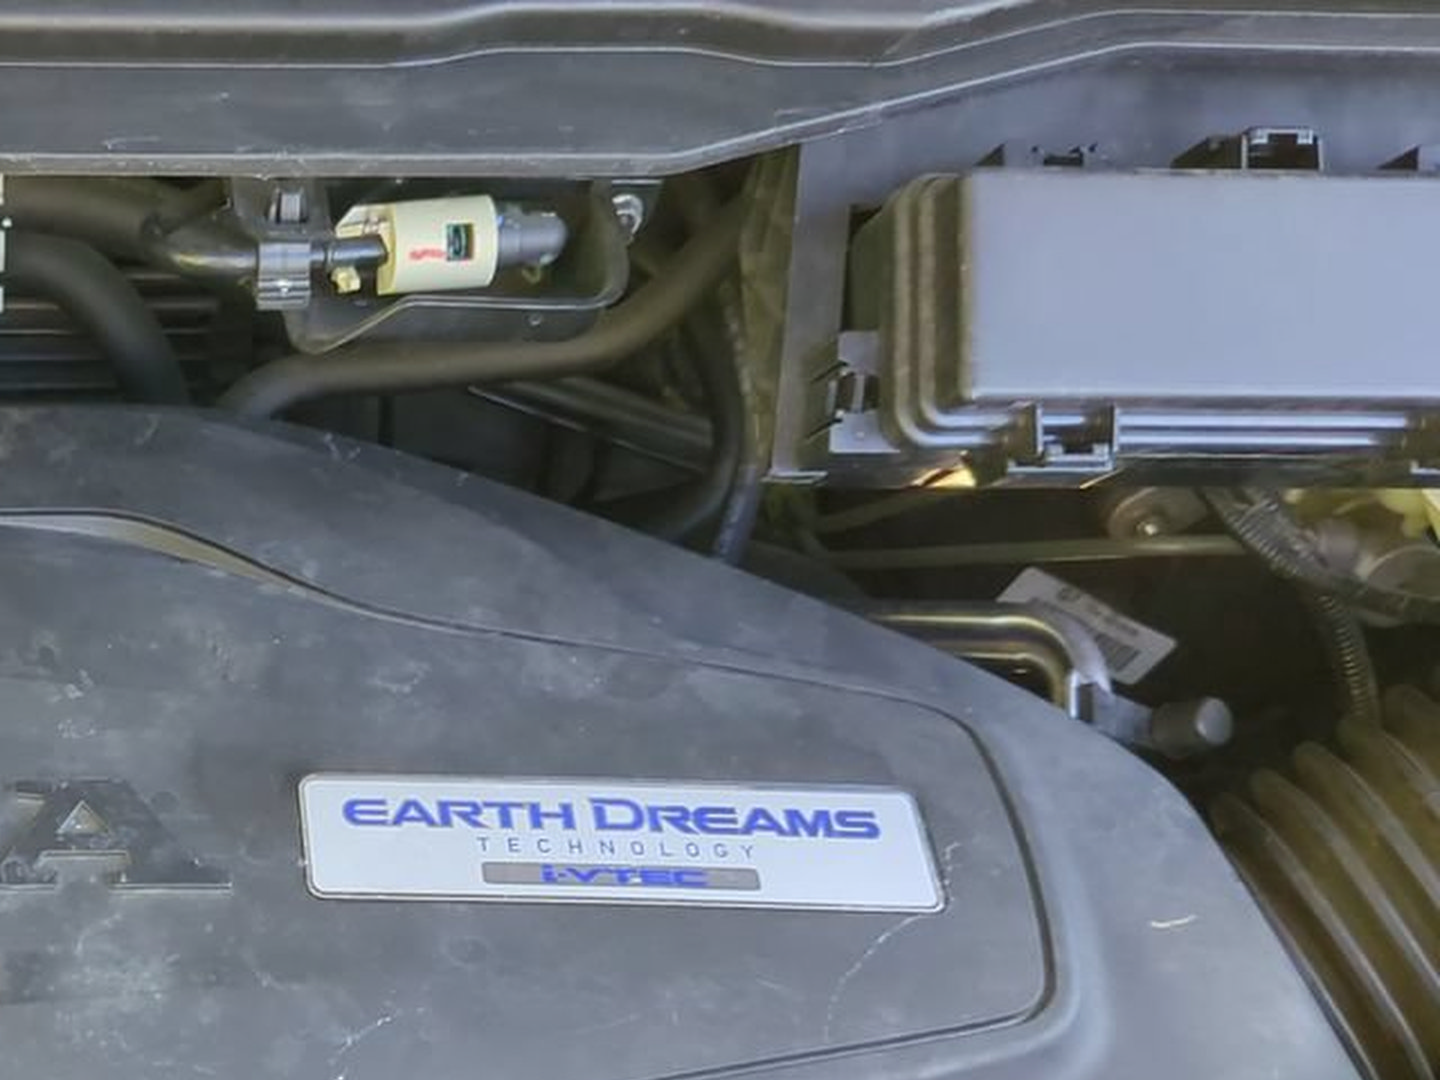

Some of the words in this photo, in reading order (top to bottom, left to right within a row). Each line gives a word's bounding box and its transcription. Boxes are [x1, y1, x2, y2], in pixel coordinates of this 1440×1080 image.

[342, 798, 577, 829] EARTH
[587, 798, 881, 840] DREAMS
[476, 836, 754, 859] TECHNOLOGY
